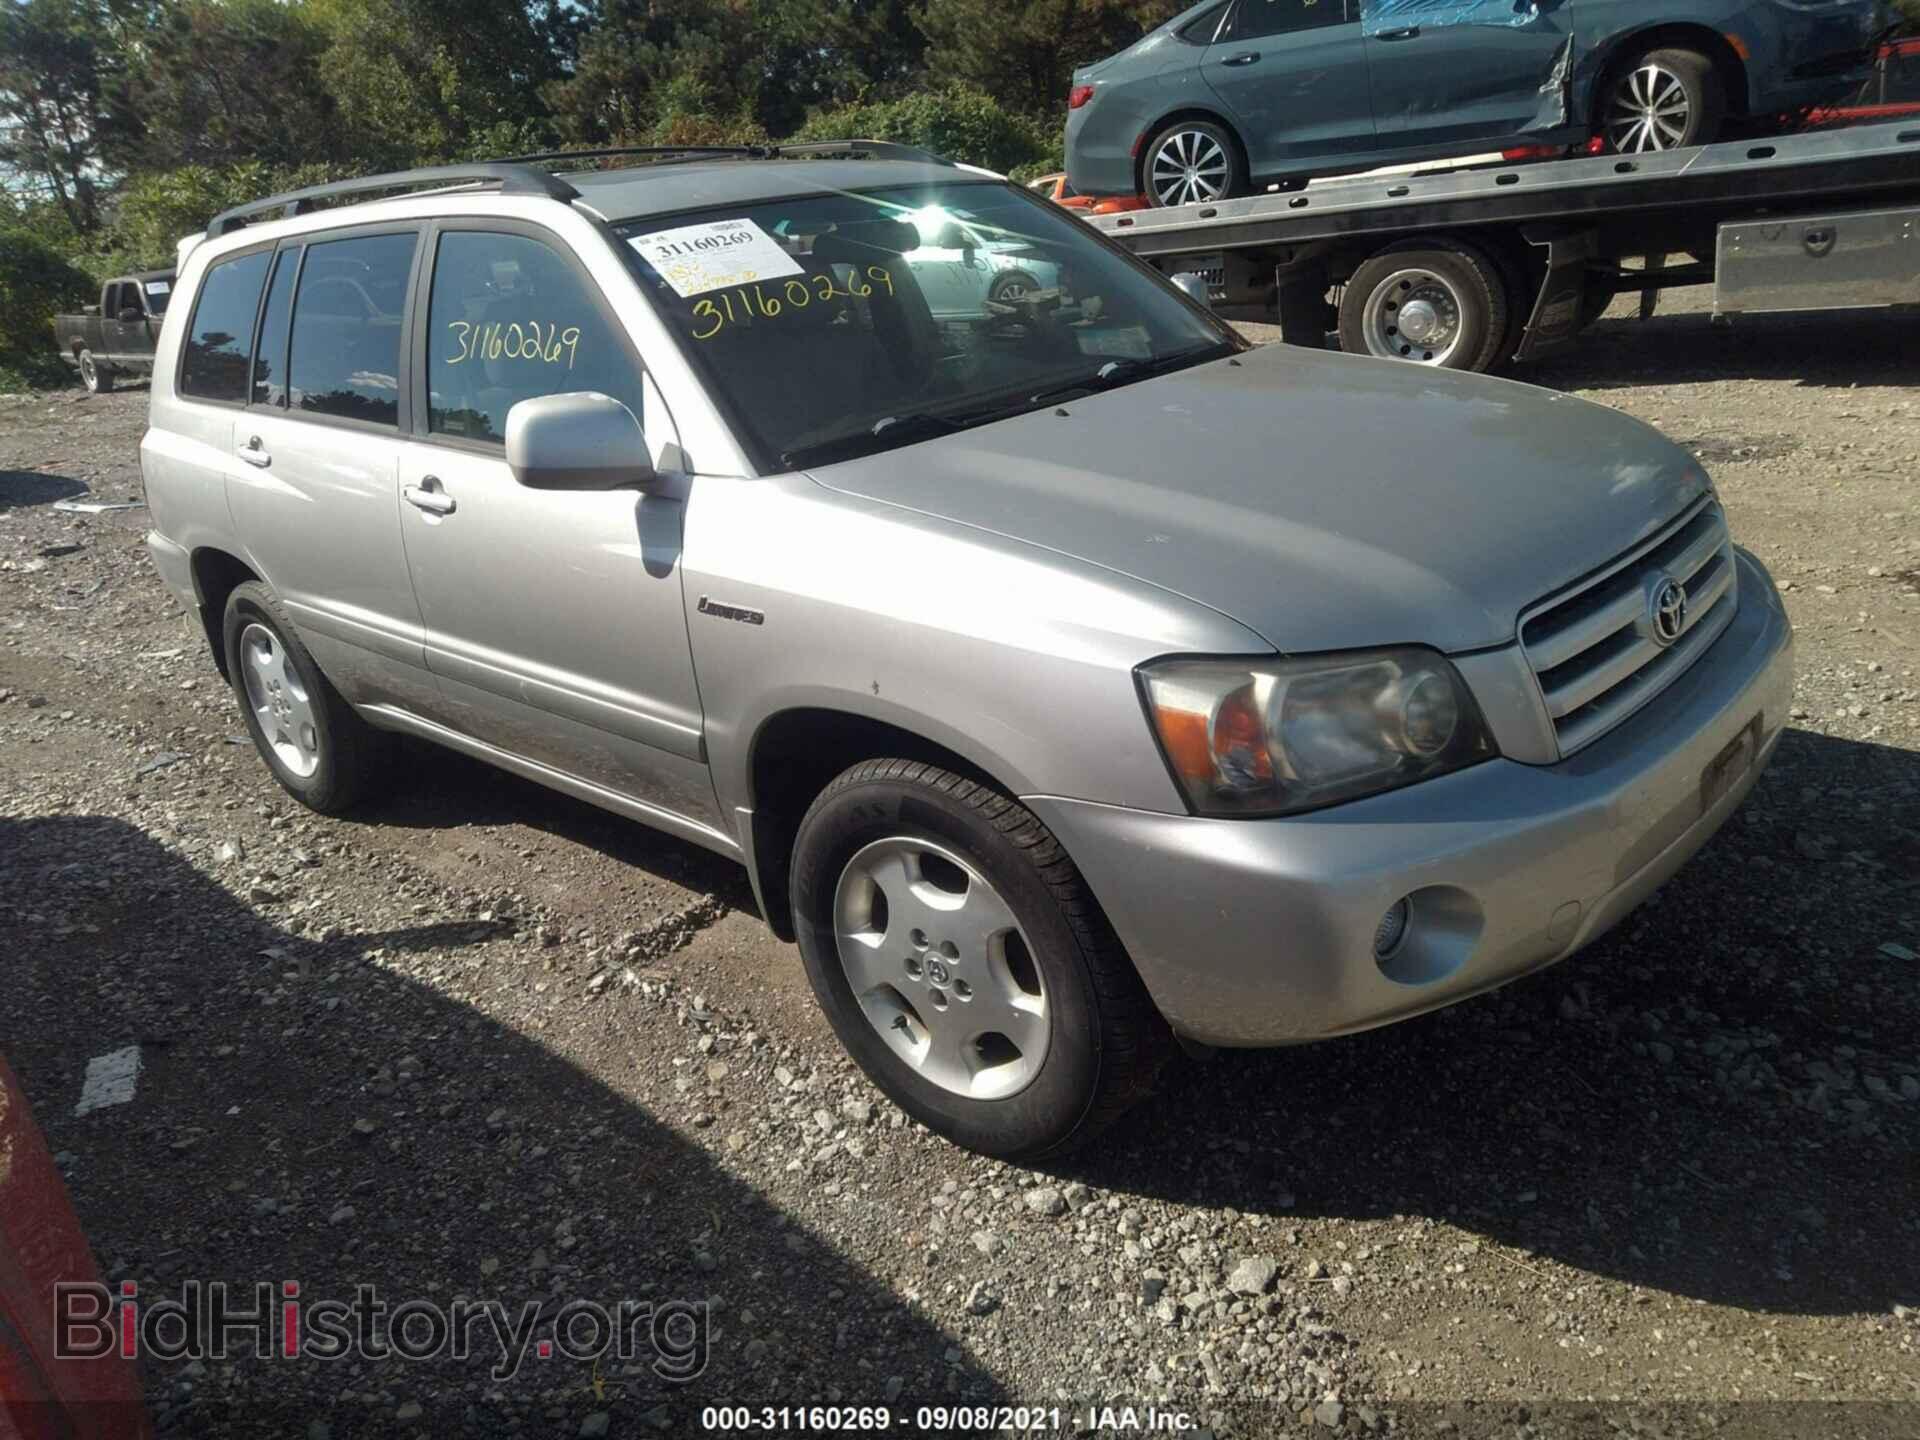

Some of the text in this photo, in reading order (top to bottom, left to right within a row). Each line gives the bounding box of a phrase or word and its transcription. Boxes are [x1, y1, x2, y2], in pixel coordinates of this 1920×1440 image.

[655, 231, 754, 259] 31160269
[691, 266, 896, 340] 31160269
[445, 320, 581, 370] 31160269
